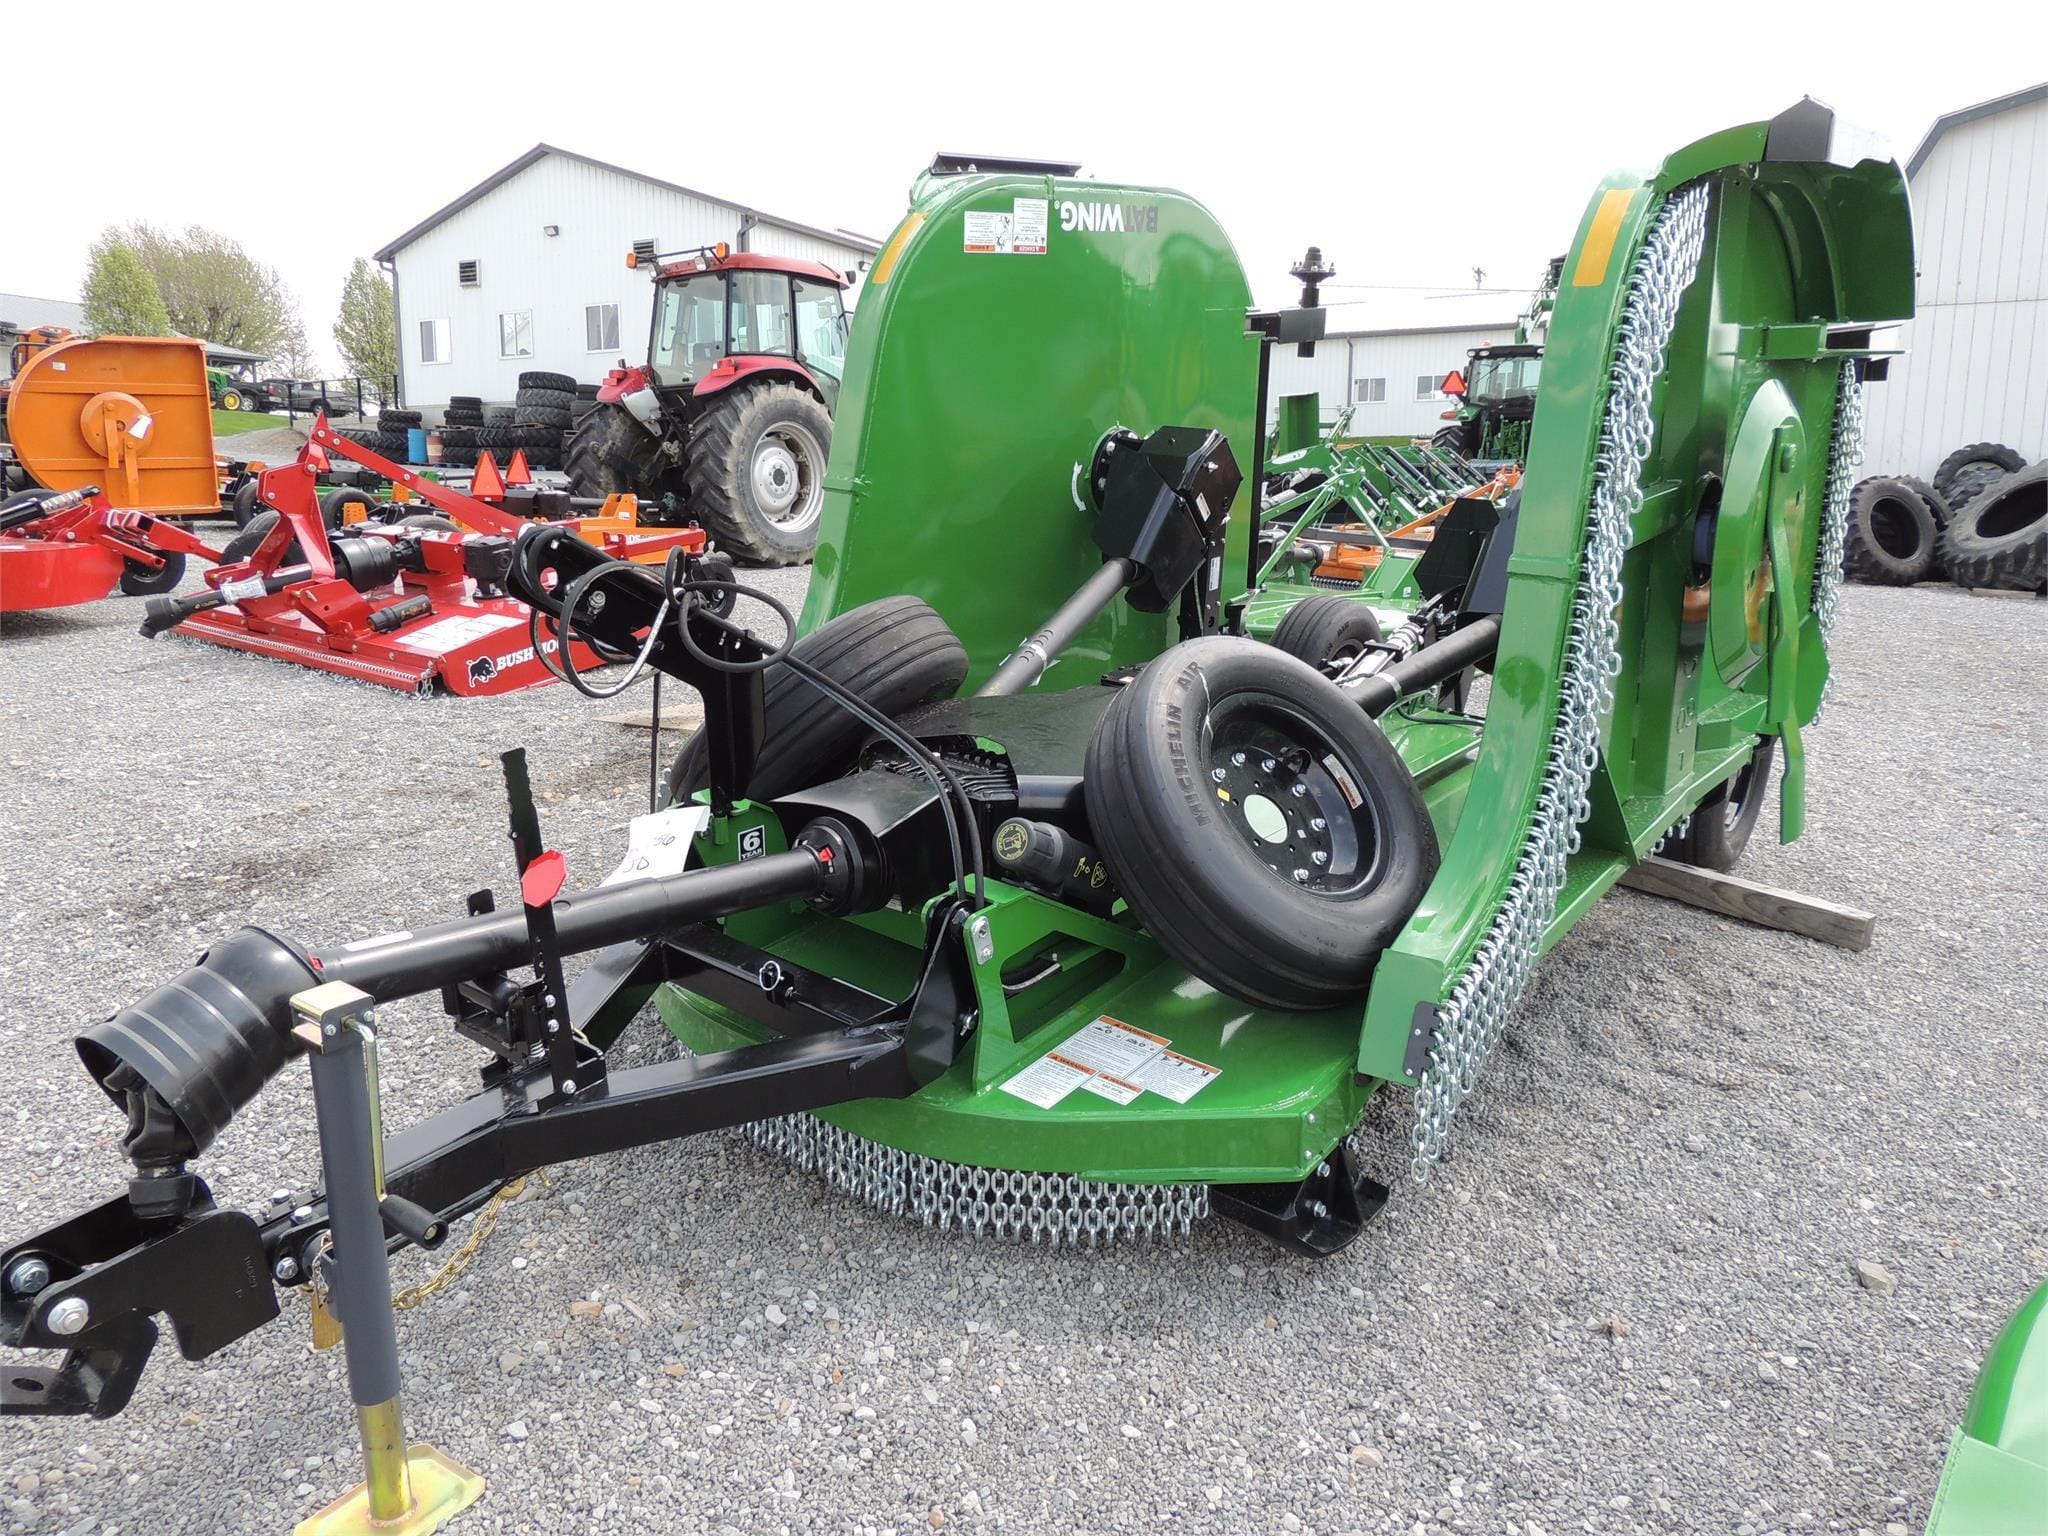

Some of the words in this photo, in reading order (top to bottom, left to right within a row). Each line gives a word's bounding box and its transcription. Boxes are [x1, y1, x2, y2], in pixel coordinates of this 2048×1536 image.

[496, 646, 534, 671] BUSH
[1176, 661, 1204, 692] AIR
[1166, 703, 1211, 827] MICHELIN
[743, 831, 761, 851] 6
[741, 849, 763, 860] YEAR
